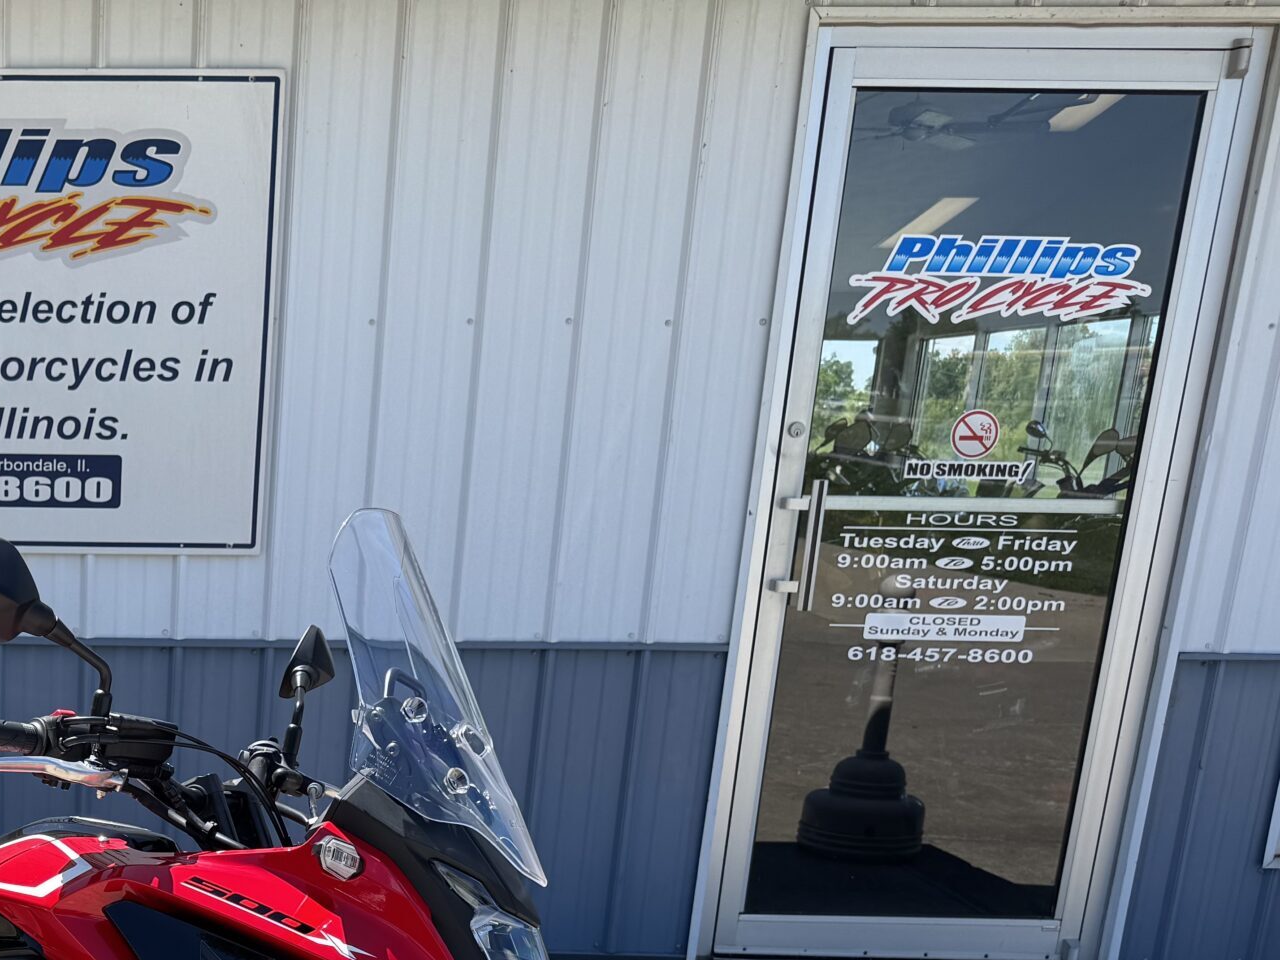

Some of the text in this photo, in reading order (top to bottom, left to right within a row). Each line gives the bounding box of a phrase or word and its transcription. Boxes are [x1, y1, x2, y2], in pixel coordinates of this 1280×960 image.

[886, 237, 1137, 278] Phillips
[853, 276, 1148, 321] PRO CYCLE
[170, 293, 217, 325] of
[194, 352, 234, 382] in
[907, 462, 1033, 482] NO SMOKING!
[906, 513, 1018, 526] HOURS
[840, 533, 945, 552] Tuesday
[997, 536, 1077, 554] Friday
[837, 554, 927, 569] 9:00am
[981, 556, 1072, 574] 5:00pm
[895, 574, 1008, 593] Saturday
[831, 594, 920, 608] 9:00am
[973, 596, 1065, 614] 2:00pm
[909, 616, 981, 626] CLOSED
[868, 625, 1020, 638] Sunday & Monday
[847, 646, 1033, 663] 618-457-8600
